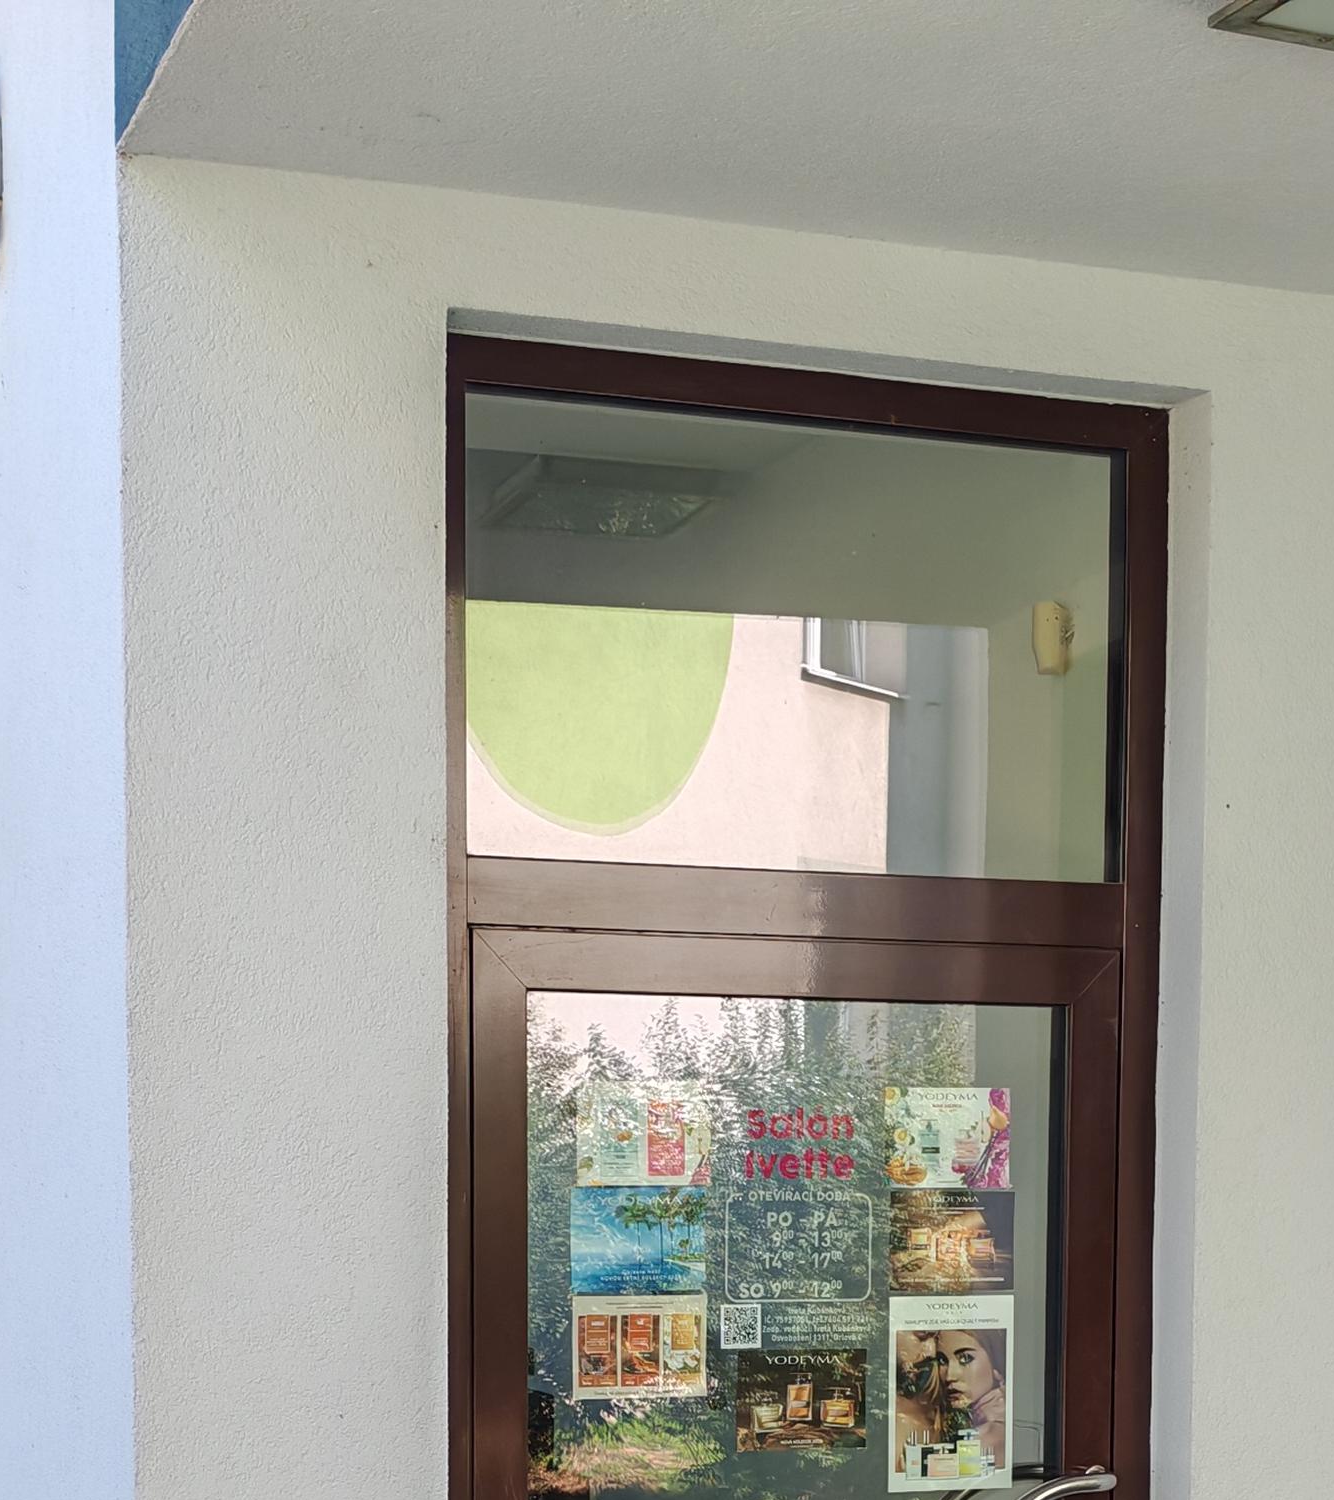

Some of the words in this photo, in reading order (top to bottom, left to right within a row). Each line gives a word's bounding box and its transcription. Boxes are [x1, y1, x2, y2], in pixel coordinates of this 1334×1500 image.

[744, 1146, 856, 1181] Ivette
[766, 1210, 793, 1228] PO
[738, 1282, 765, 1299] SO
[925, 1302, 979, 1311] YODEYMA
[764, 1354, 842, 1366] YODEYMA
